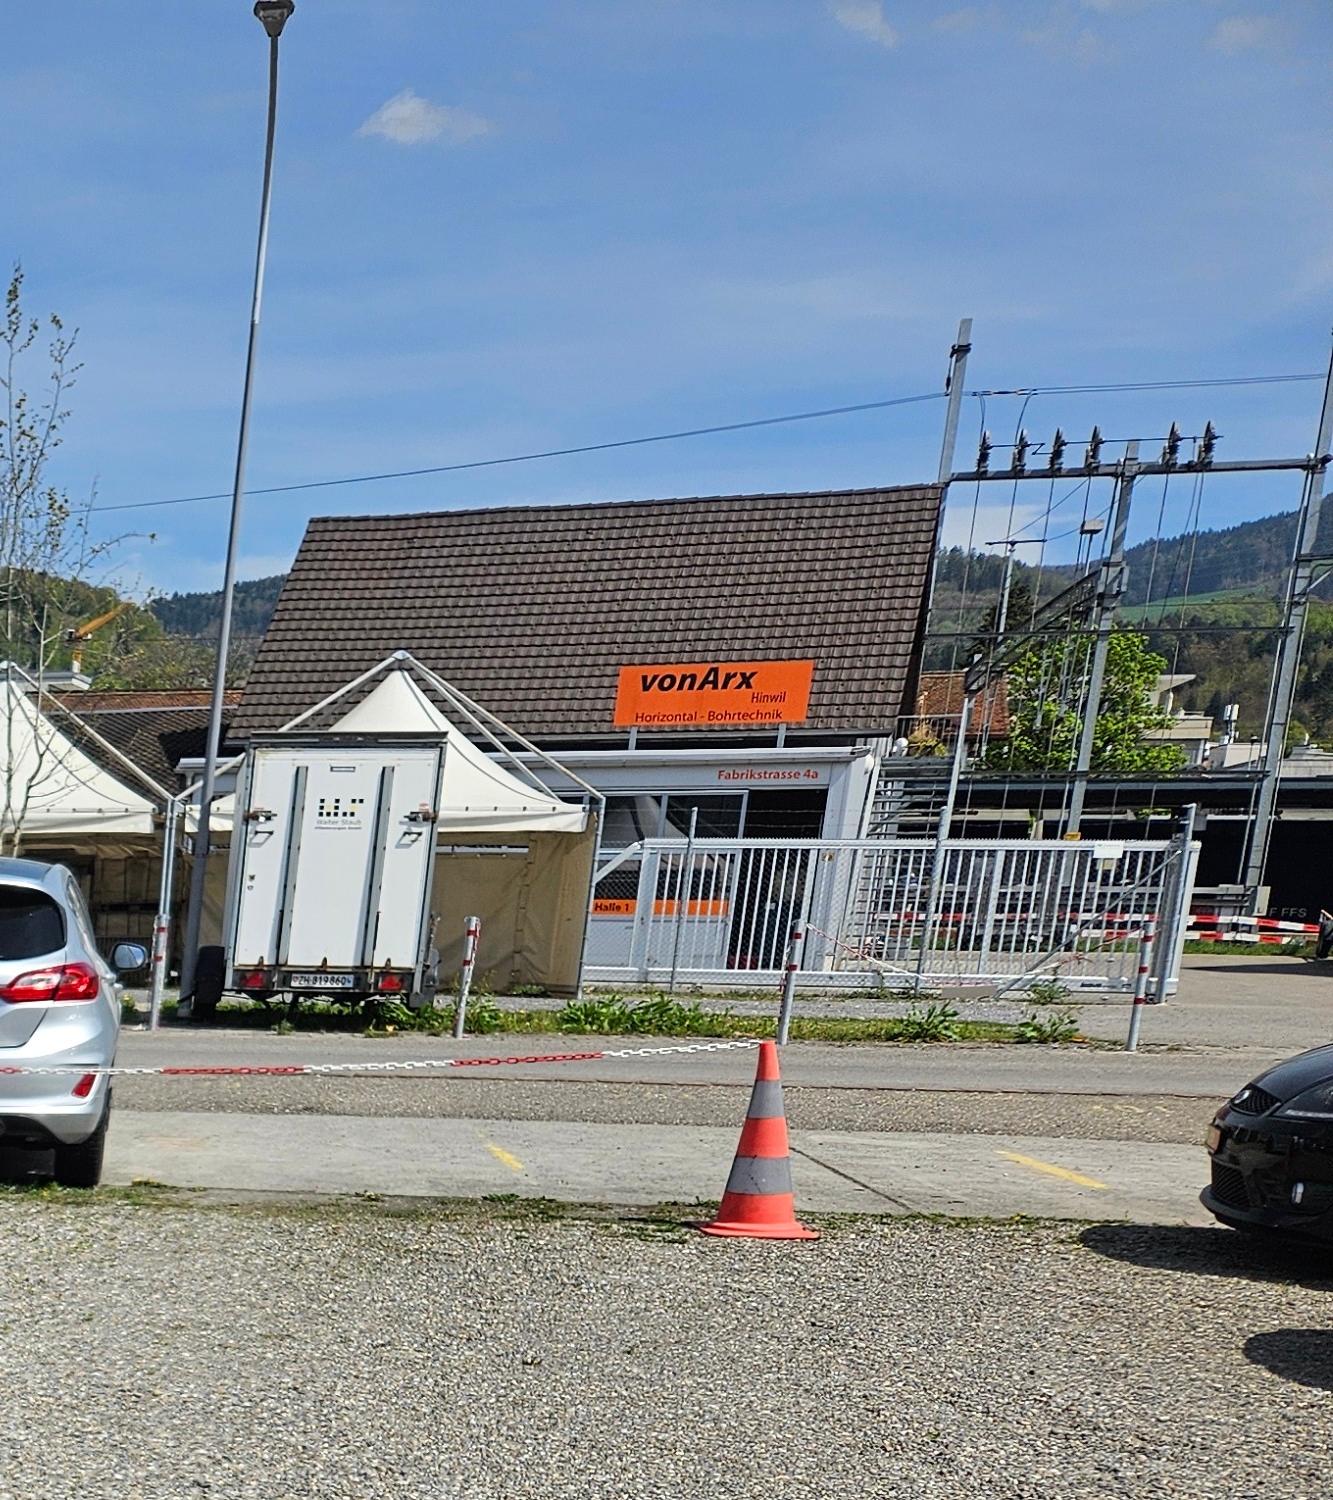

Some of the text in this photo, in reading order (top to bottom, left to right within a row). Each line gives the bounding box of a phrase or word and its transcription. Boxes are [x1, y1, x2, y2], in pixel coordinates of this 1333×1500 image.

[641, 666, 758, 692] vonArx
[751, 691, 786, 704] Hinwil
[635, 711, 697, 723] Horizontal
[708, 710, 783, 722] Bohrtechnik
[717, 768, 819, 780] Fabrikstrasse 4a
